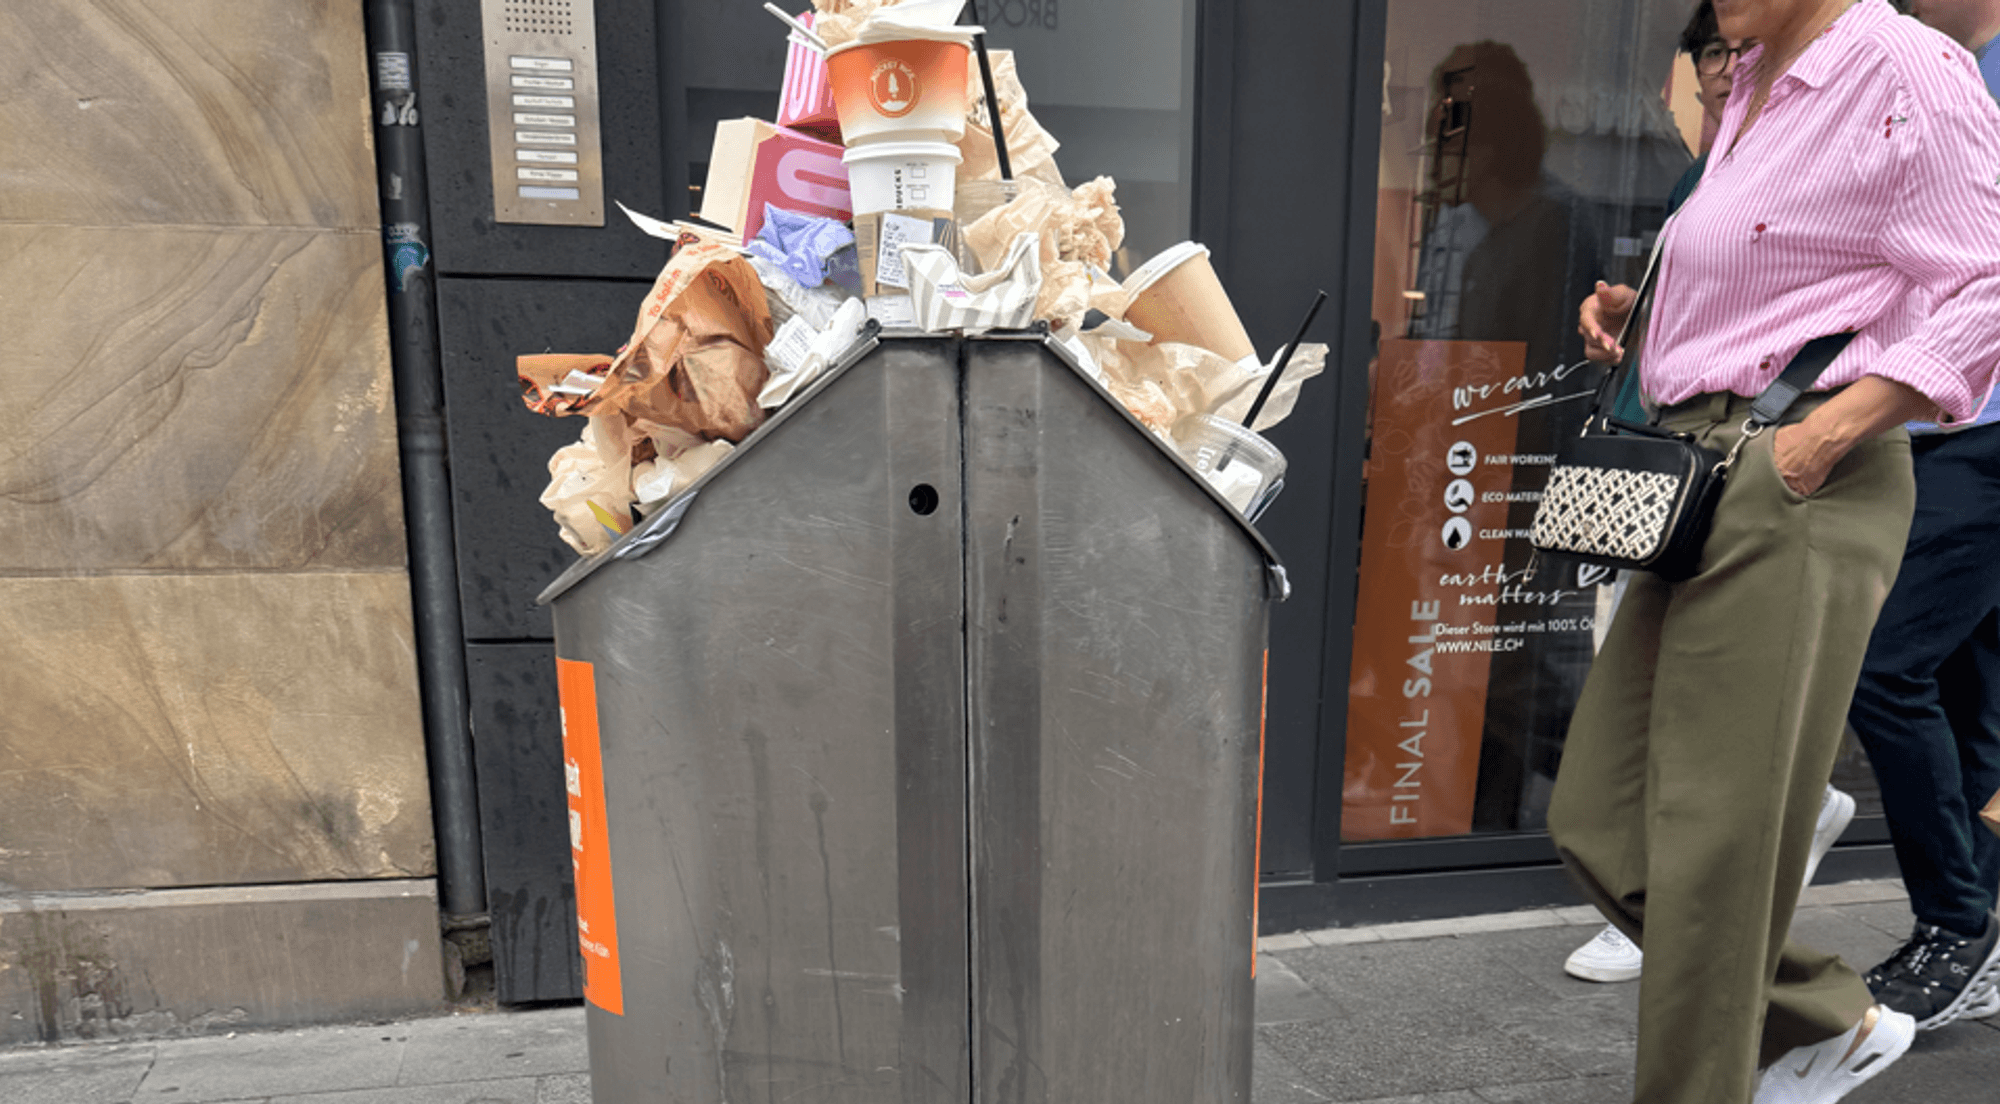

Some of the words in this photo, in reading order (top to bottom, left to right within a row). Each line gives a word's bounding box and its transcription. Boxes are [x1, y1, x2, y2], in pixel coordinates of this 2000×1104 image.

[1453, 382, 1501, 411] we
[1503, 359, 1590, 394] care
[1483, 454, 1508, 466] FAIR
[1481, 491, 1504, 503] ECO
[1479, 528, 1512, 540] CLEAN
[1439, 562, 1536, 587] earth
[1459, 583, 1579, 606] matters
[1435, 622, 1470, 636] Dieser
[1472, 621, 1501, 634] Store
[1503, 620, 1526, 633] wird
[1528, 620, 1546, 633] mit
[1548, 618, 1578, 631] 100%
[1403, 599, 1441, 699] SALE
[1435, 637, 1525, 654] WWW.NILE.CH
[1390, 709, 1429, 825] FINAL
